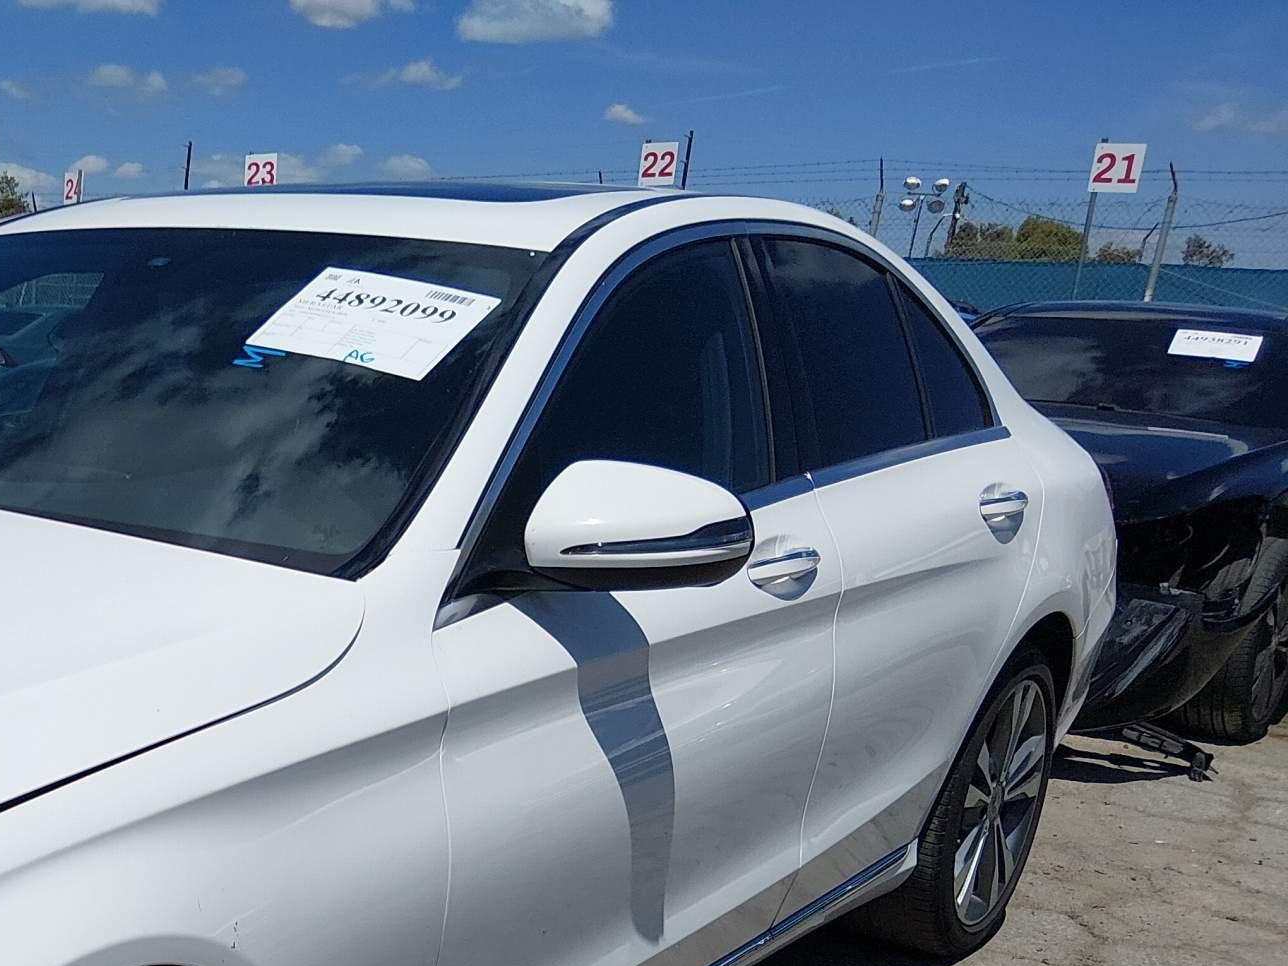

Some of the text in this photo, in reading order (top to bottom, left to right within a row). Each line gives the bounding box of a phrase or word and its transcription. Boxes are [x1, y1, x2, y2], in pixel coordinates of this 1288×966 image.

[247, 161, 275, 185] 23
[641, 151, 675, 178] 22
[1092, 152, 1137, 184] 21
[315, 288, 457, 324] 44892099
